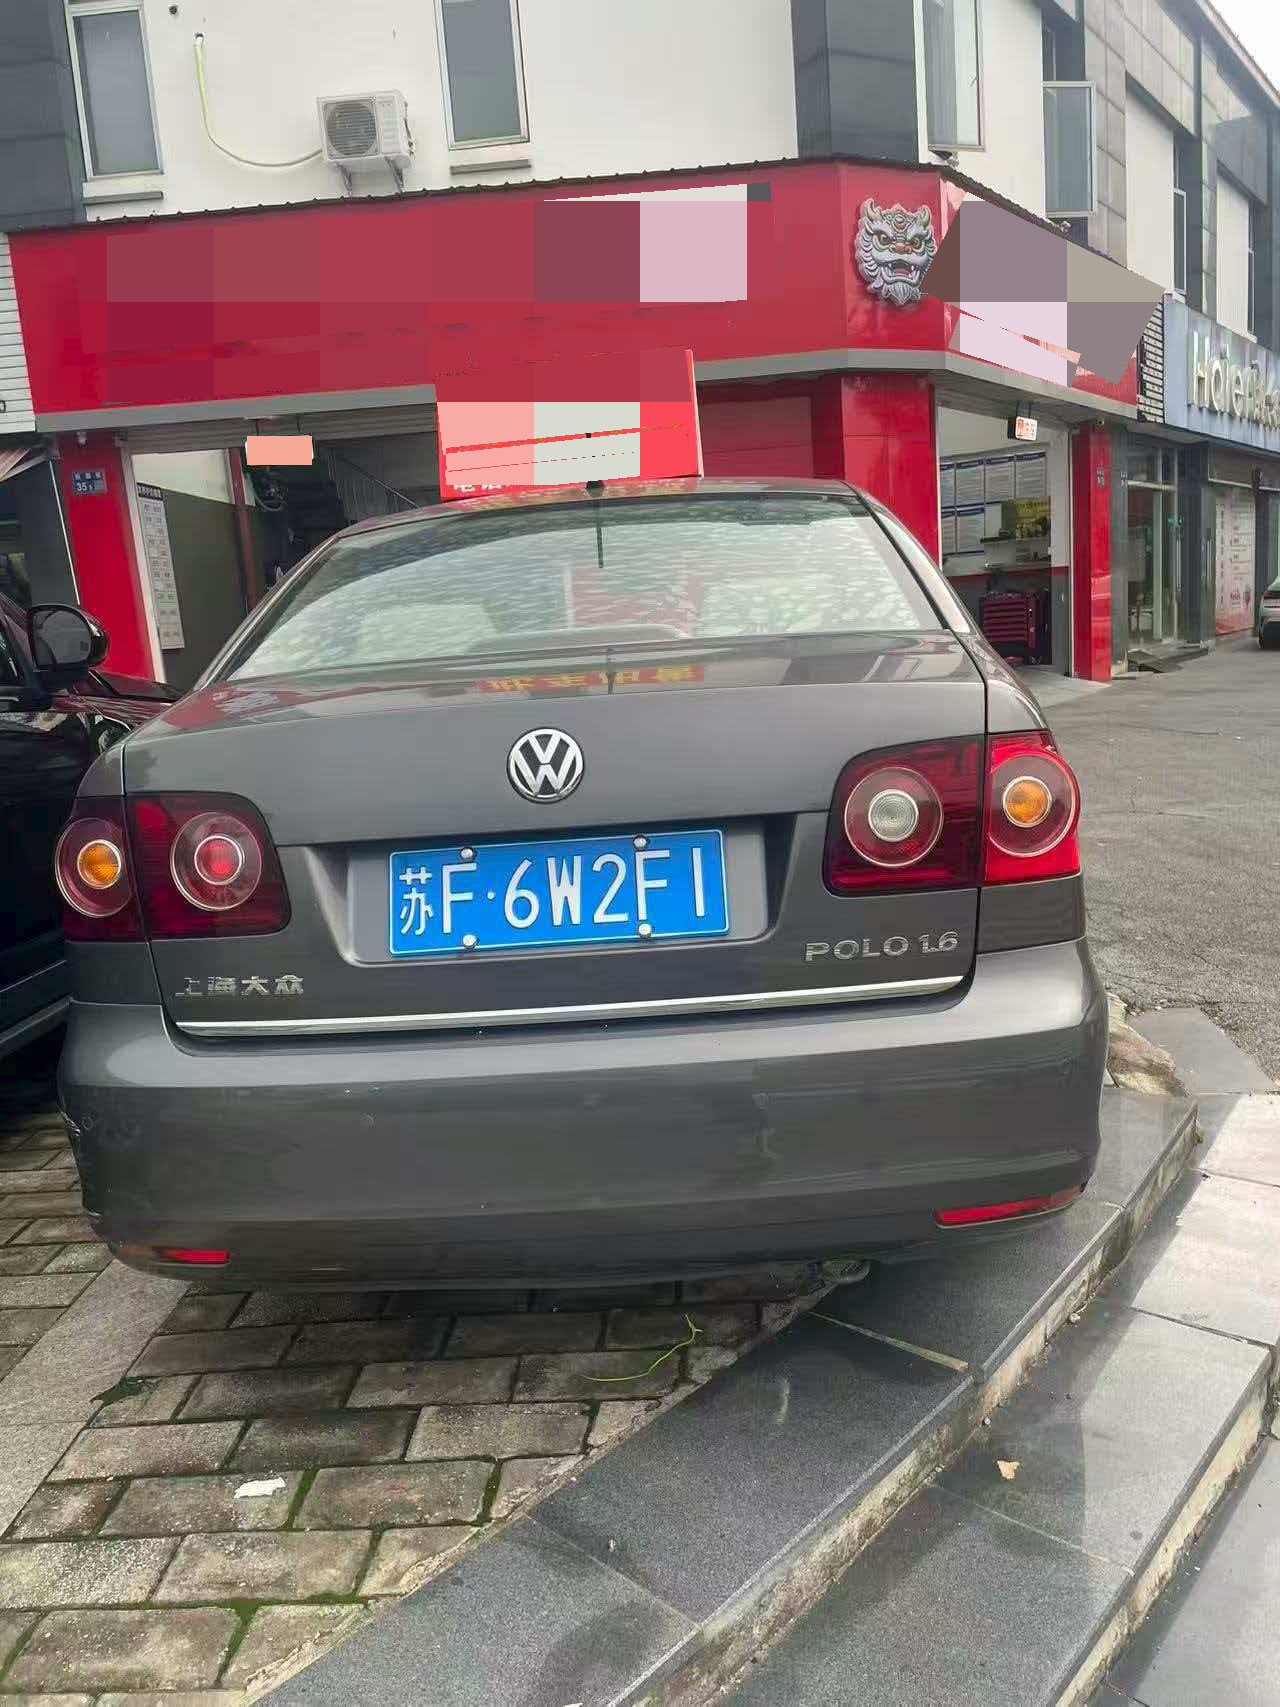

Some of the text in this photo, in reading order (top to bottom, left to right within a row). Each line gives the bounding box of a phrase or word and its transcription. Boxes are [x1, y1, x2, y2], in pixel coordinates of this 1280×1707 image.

[805, 931, 959, 962] POLO 1.6
[175, 974, 304, 997] 上海大众
